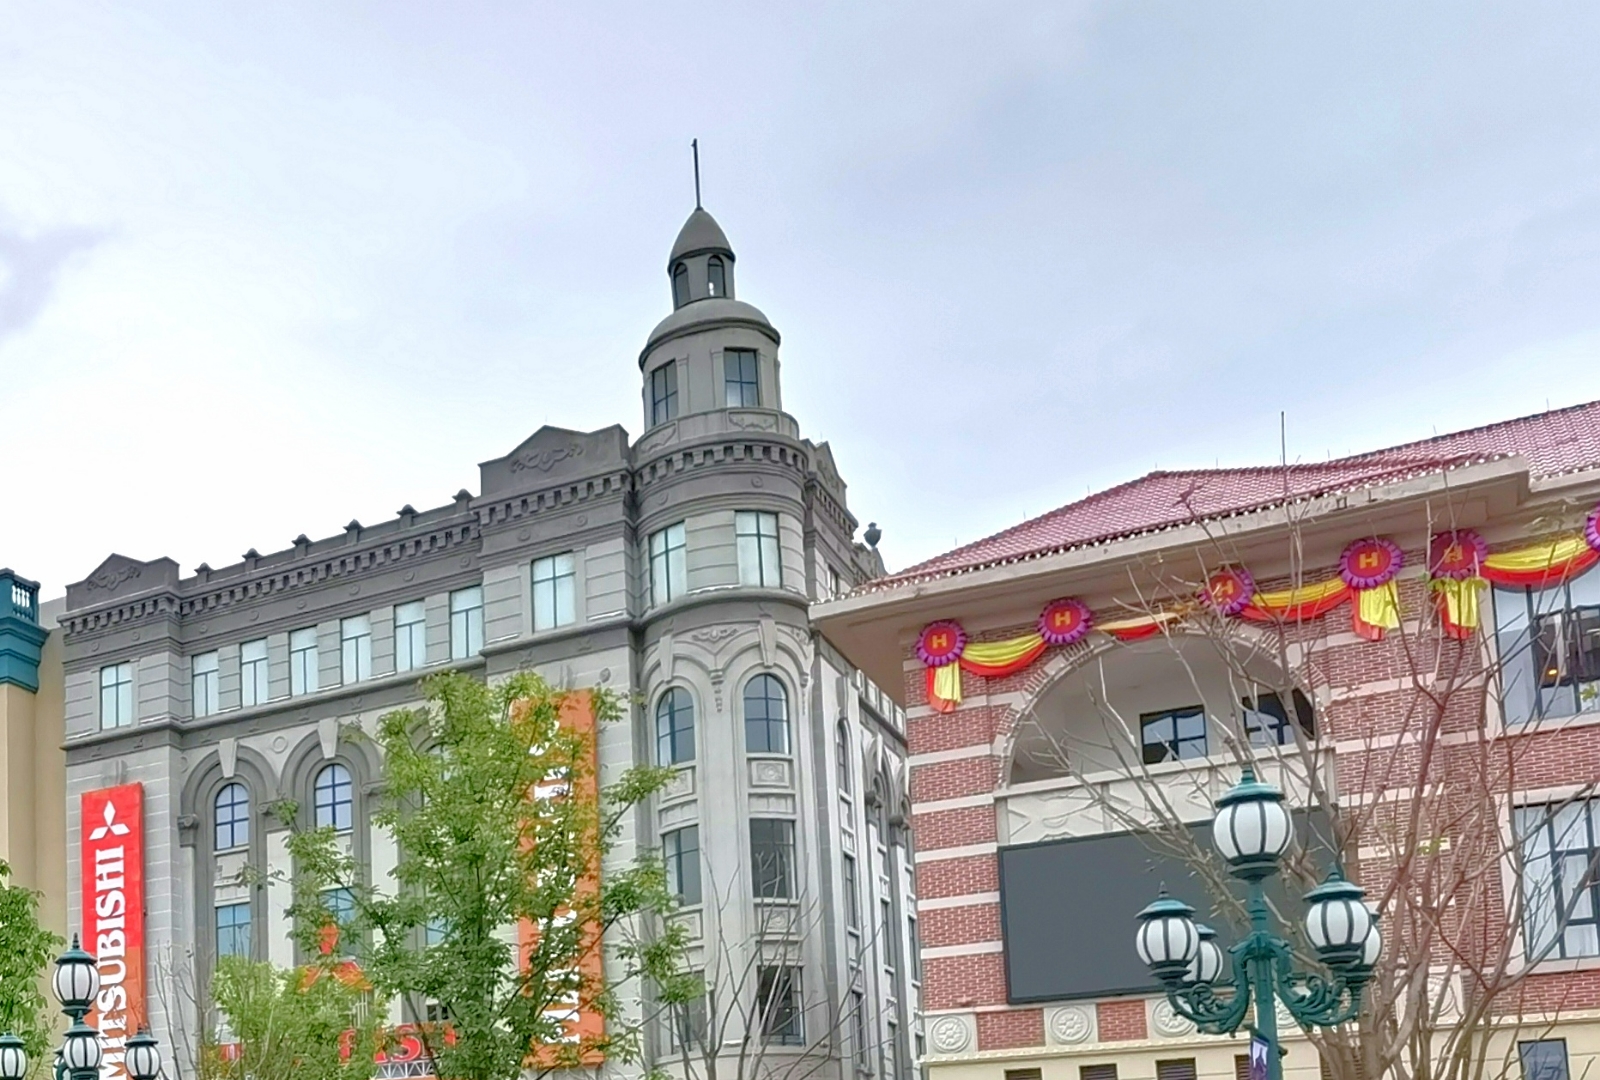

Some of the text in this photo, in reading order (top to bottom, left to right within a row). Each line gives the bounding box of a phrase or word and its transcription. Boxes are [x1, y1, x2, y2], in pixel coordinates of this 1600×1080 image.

[1359, 552, 1378, 569] H
[1054, 610, 1072, 627] H
[931, 633, 948, 650] H
